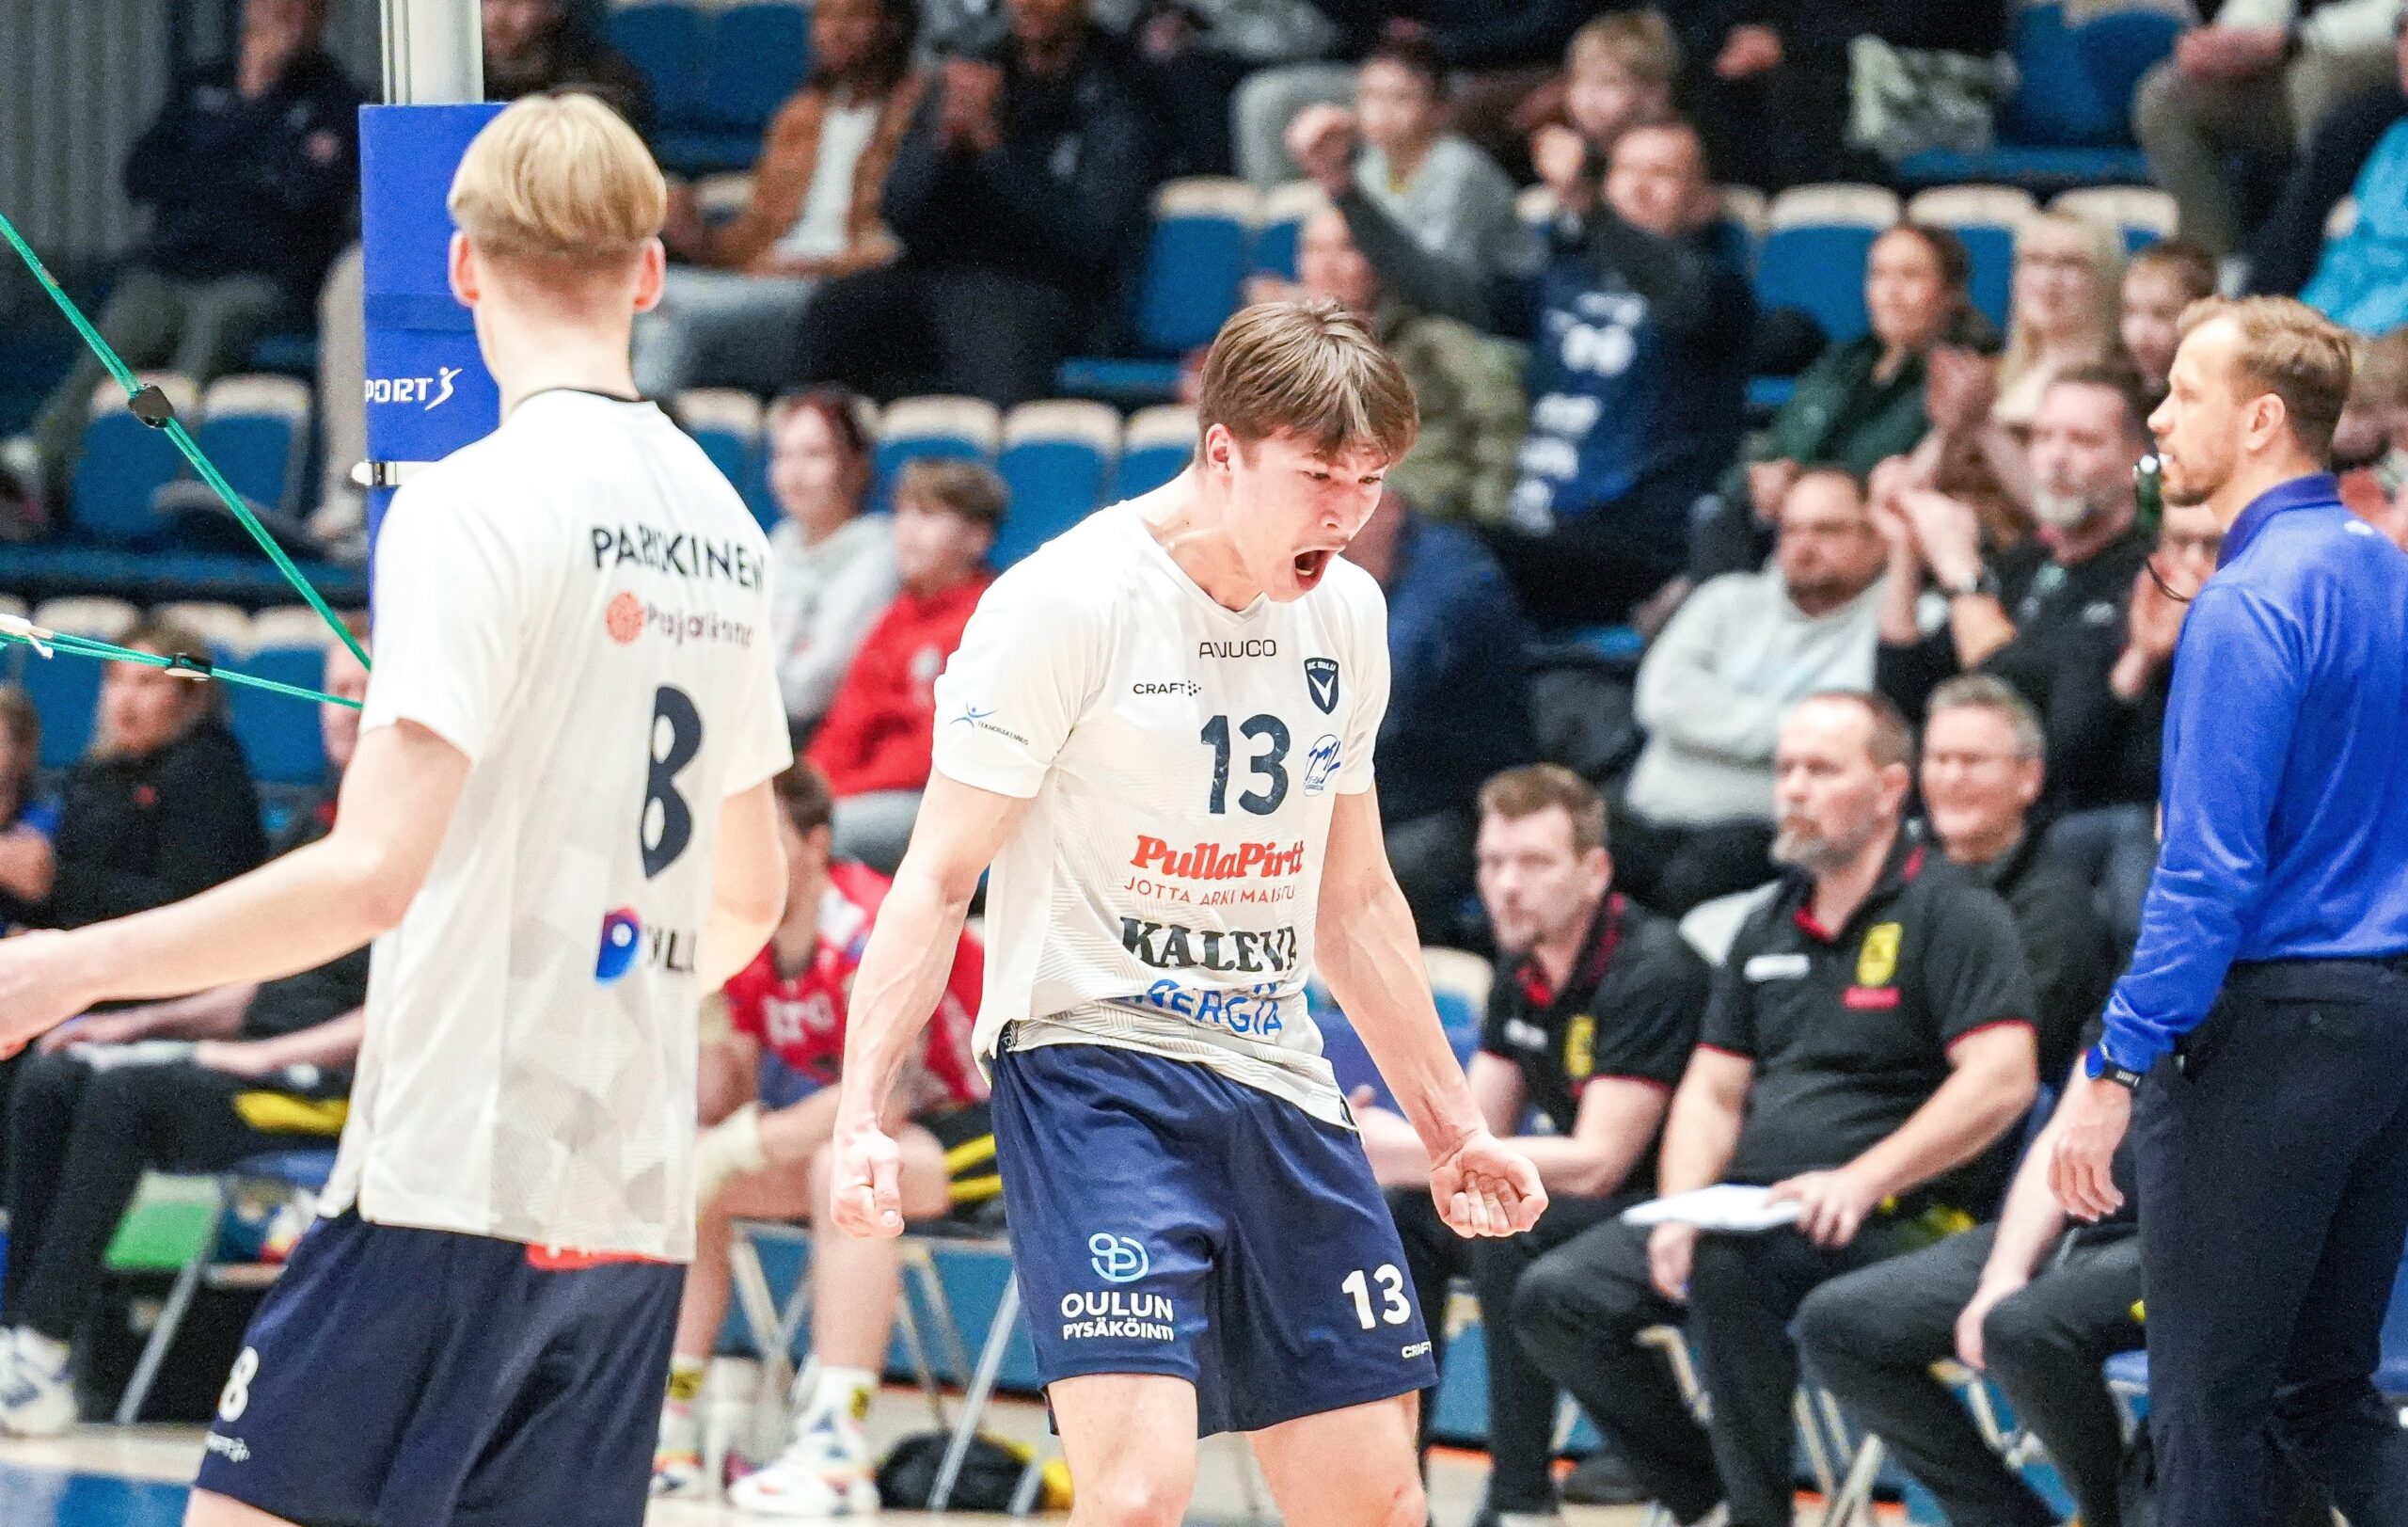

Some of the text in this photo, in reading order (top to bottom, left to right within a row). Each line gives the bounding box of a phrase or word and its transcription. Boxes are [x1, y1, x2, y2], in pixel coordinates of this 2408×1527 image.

[1199, 640, 1276, 659] ANUCO
[1133, 683, 1185, 695] CRAFT
[1201, 714, 1291, 816] 13
[1124, 876, 1190, 902] JOTTA
[1200, 888, 1235, 905] ARKI
[1119, 916, 1297, 972] KALEVA
[1061, 1291, 1174, 1322] OULUN
[1341, 1264, 1411, 1329] 13
[1063, 1317, 1175, 1342] PYSÄKÖINTI
[218, 1345, 260, 1423] 8
